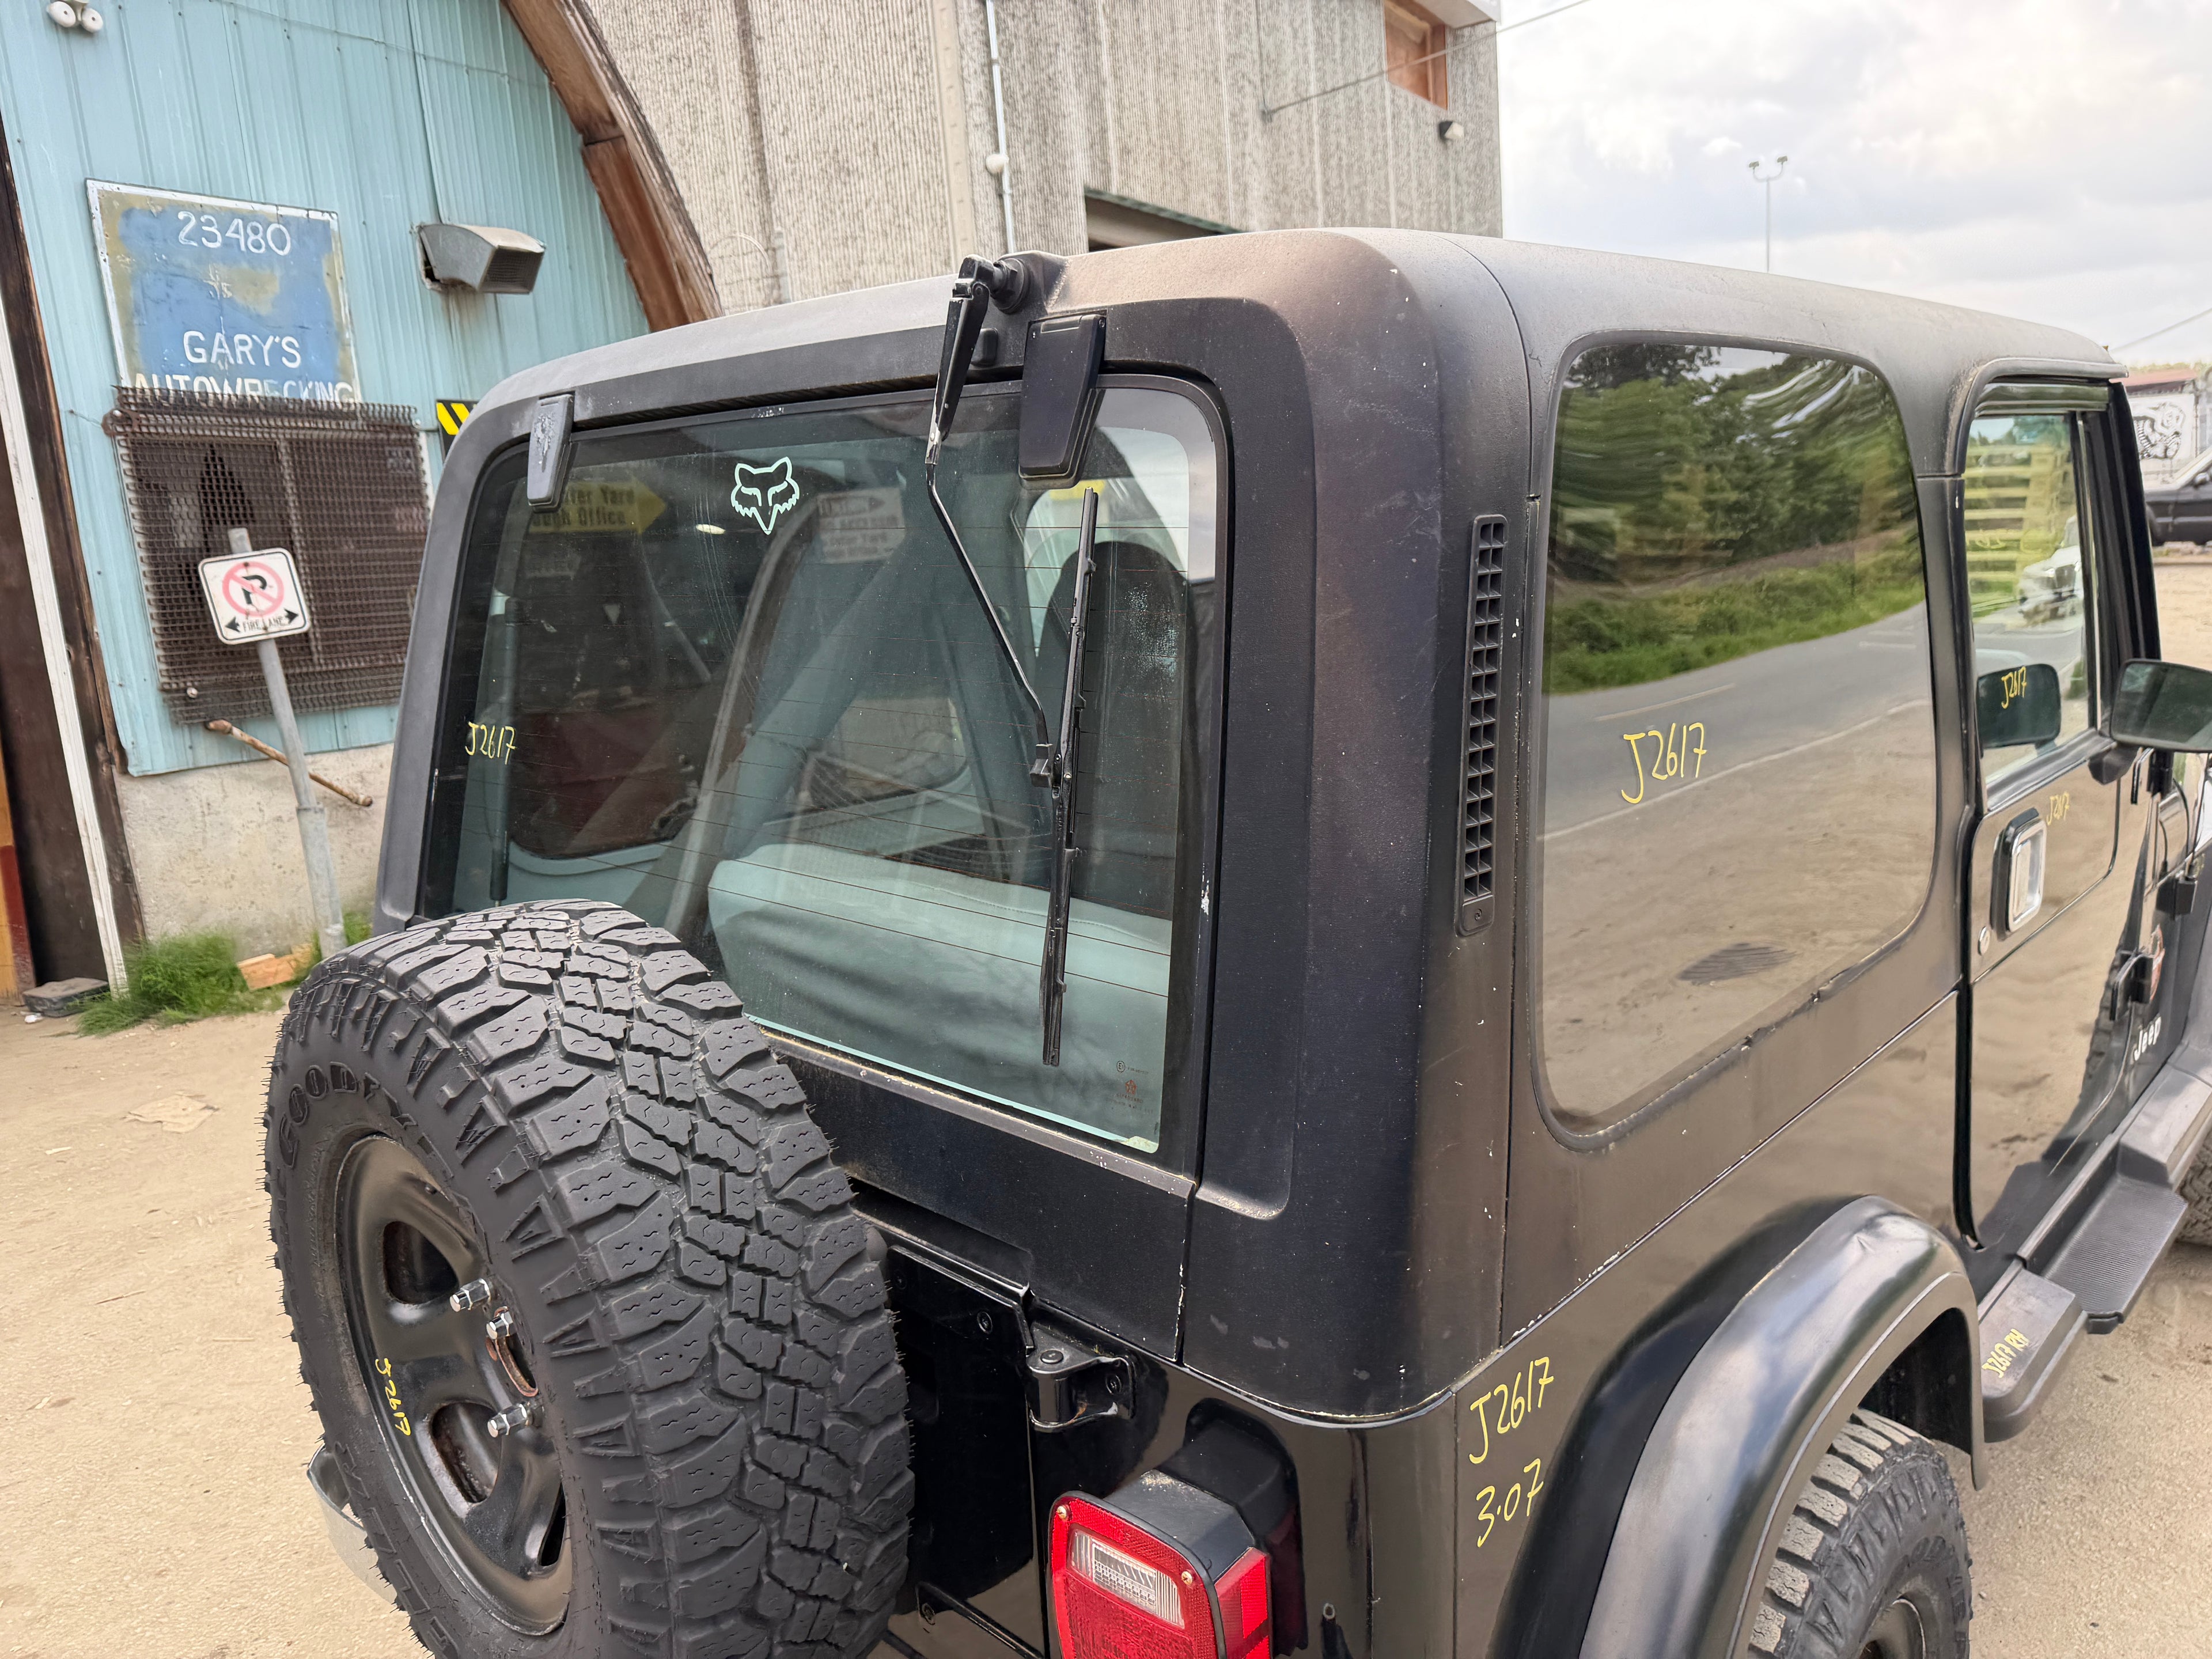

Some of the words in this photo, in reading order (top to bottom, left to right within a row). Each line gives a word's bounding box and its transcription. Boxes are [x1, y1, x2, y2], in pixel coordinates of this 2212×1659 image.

[178, 210, 291, 256] 23480
[183, 330, 302, 369] GARY'S
[465, 721, 517, 765] J2617
[1621, 722, 1708, 804] J2617
[2134, 1016, 2162, 1061] Jeep
[1982, 1342, 2017, 1378] J2617
[374, 1358, 411, 1436] J2617
[1469, 1356, 1554, 1464] J2617
[1475, 1458, 1544, 1548] 3.07
